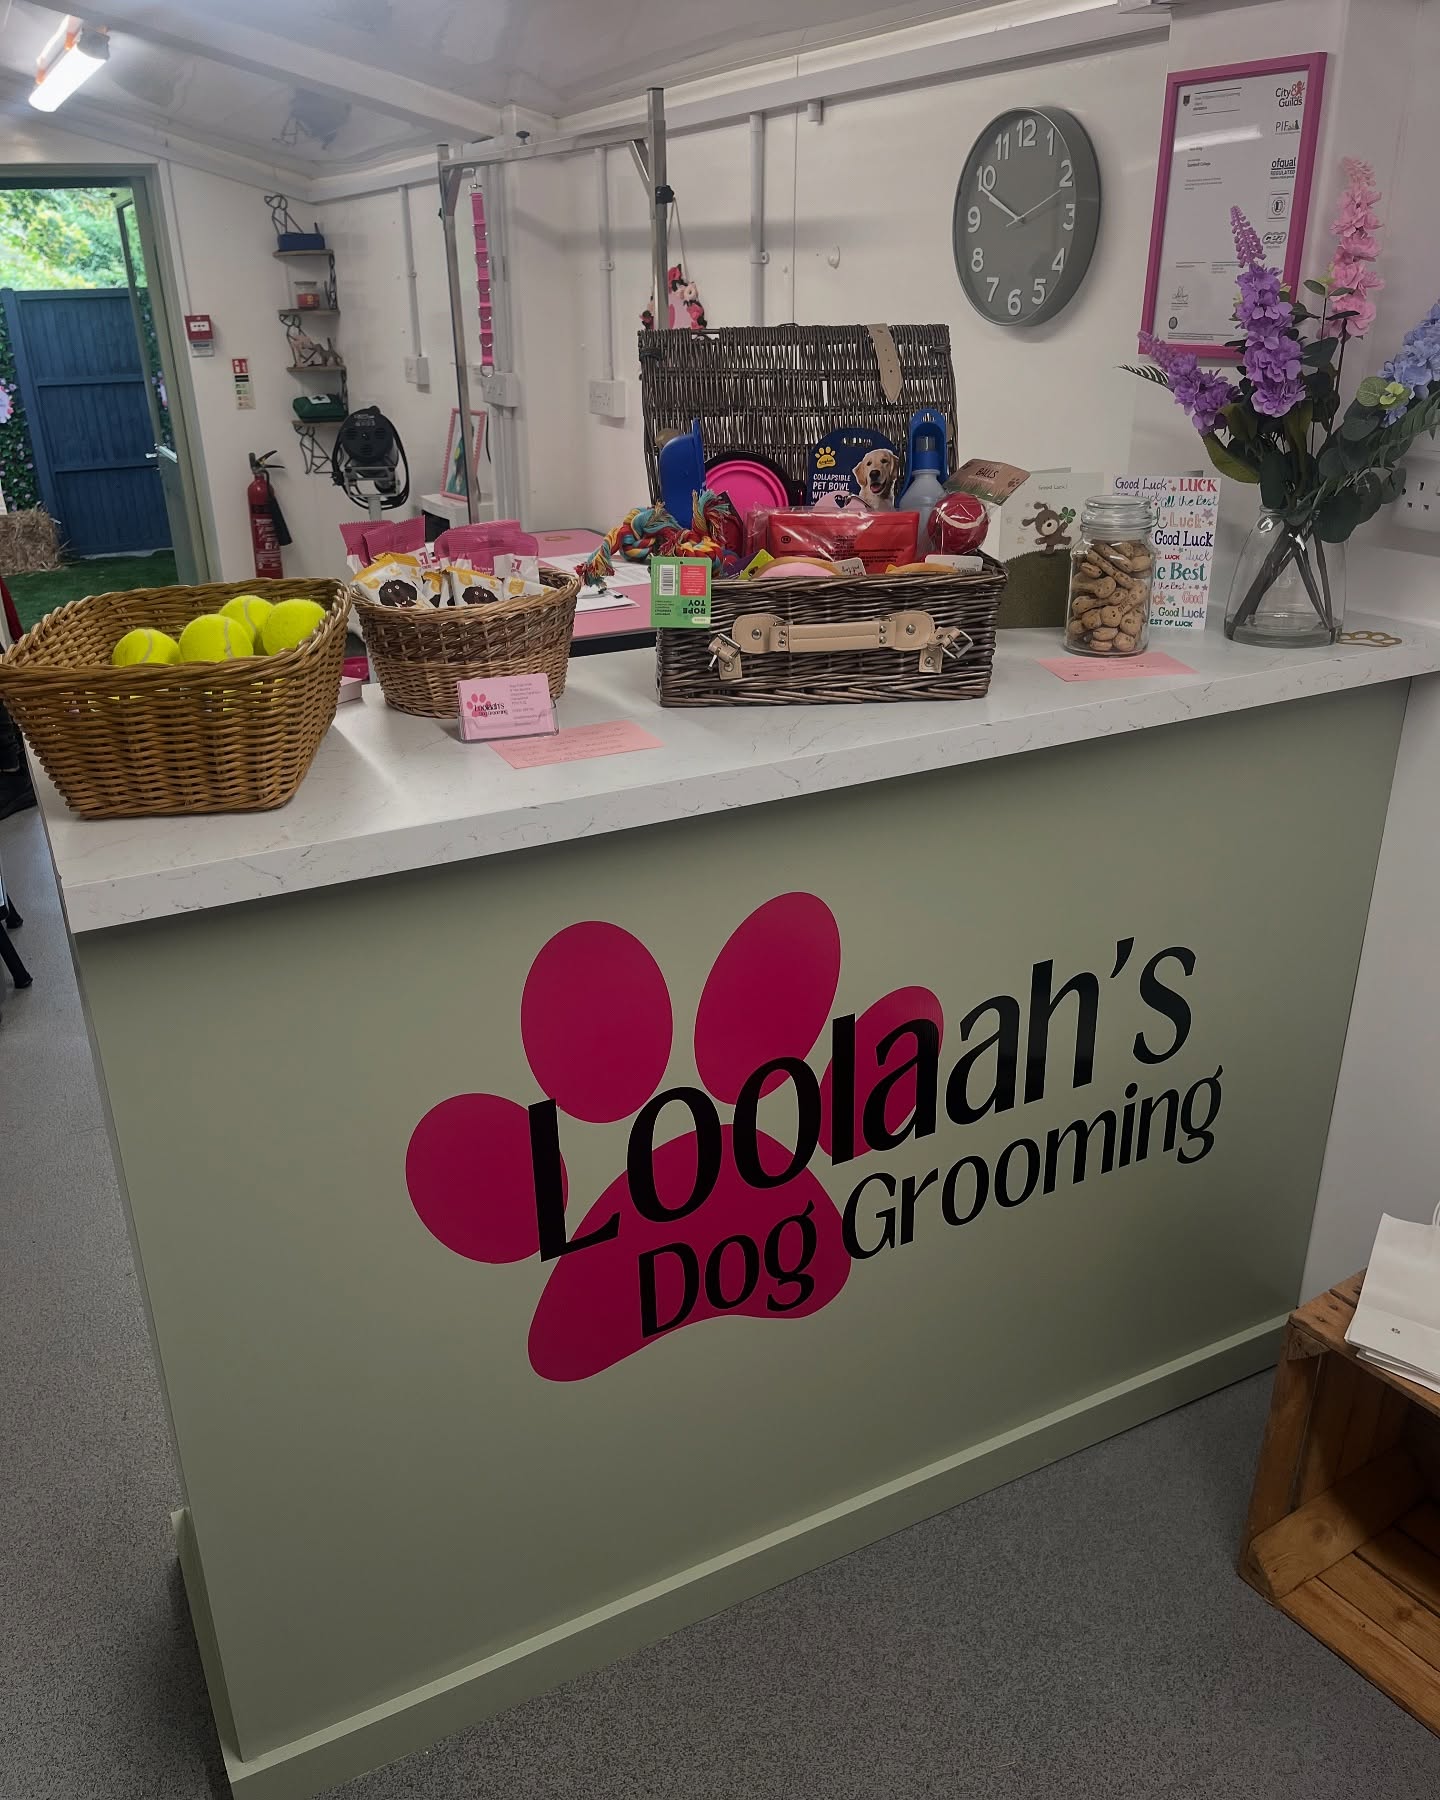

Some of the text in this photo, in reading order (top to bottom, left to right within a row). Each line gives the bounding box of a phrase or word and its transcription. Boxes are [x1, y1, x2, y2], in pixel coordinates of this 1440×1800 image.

[1275, 86, 1291, 99] City
[1278, 96, 1303, 108] Guilds
[1016, 118, 1037, 148] 12
[1046, 127, 1055, 156] 1
[995, 132, 1010, 161] 11
[1271, 156, 1296, 169] ofqual
[976, 165, 996, 191] 10
[1059, 159, 1073, 188] 2
[967, 205, 981, 233] 9
[1062, 203, 1075, 231] 3
[971, 247, 984, 273] 8
[1051, 247, 1065, 274] 4
[986, 276, 1000, 302] 7
[1031, 278, 1047, 305] 5
[1007, 288, 1023, 316] 6
[813, 473, 851, 482] COLLAPSIBLE
[975, 467, 999, 479] BALLS
[1115, 476, 1168, 491] Good Luck
[811, 490, 832, 500] WIT
[812, 481, 850, 491] PET BOWL
[1179, 478, 1217, 492] LUCK
[1169, 511, 1202, 529] Luck
[1154, 529, 1214, 547] Good Luck
[1170, 561, 1208, 582] Best
[688, 599, 706, 607] TOY
[1158, 606, 1205, 619] Good Luck
[1164, 619, 1174, 627] OF
[1174, 620, 1193, 628] LUCK
[527, 936, 1197, 1263] Loolaah's
[638, 1064, 1224, 1339] Dog Grooming
